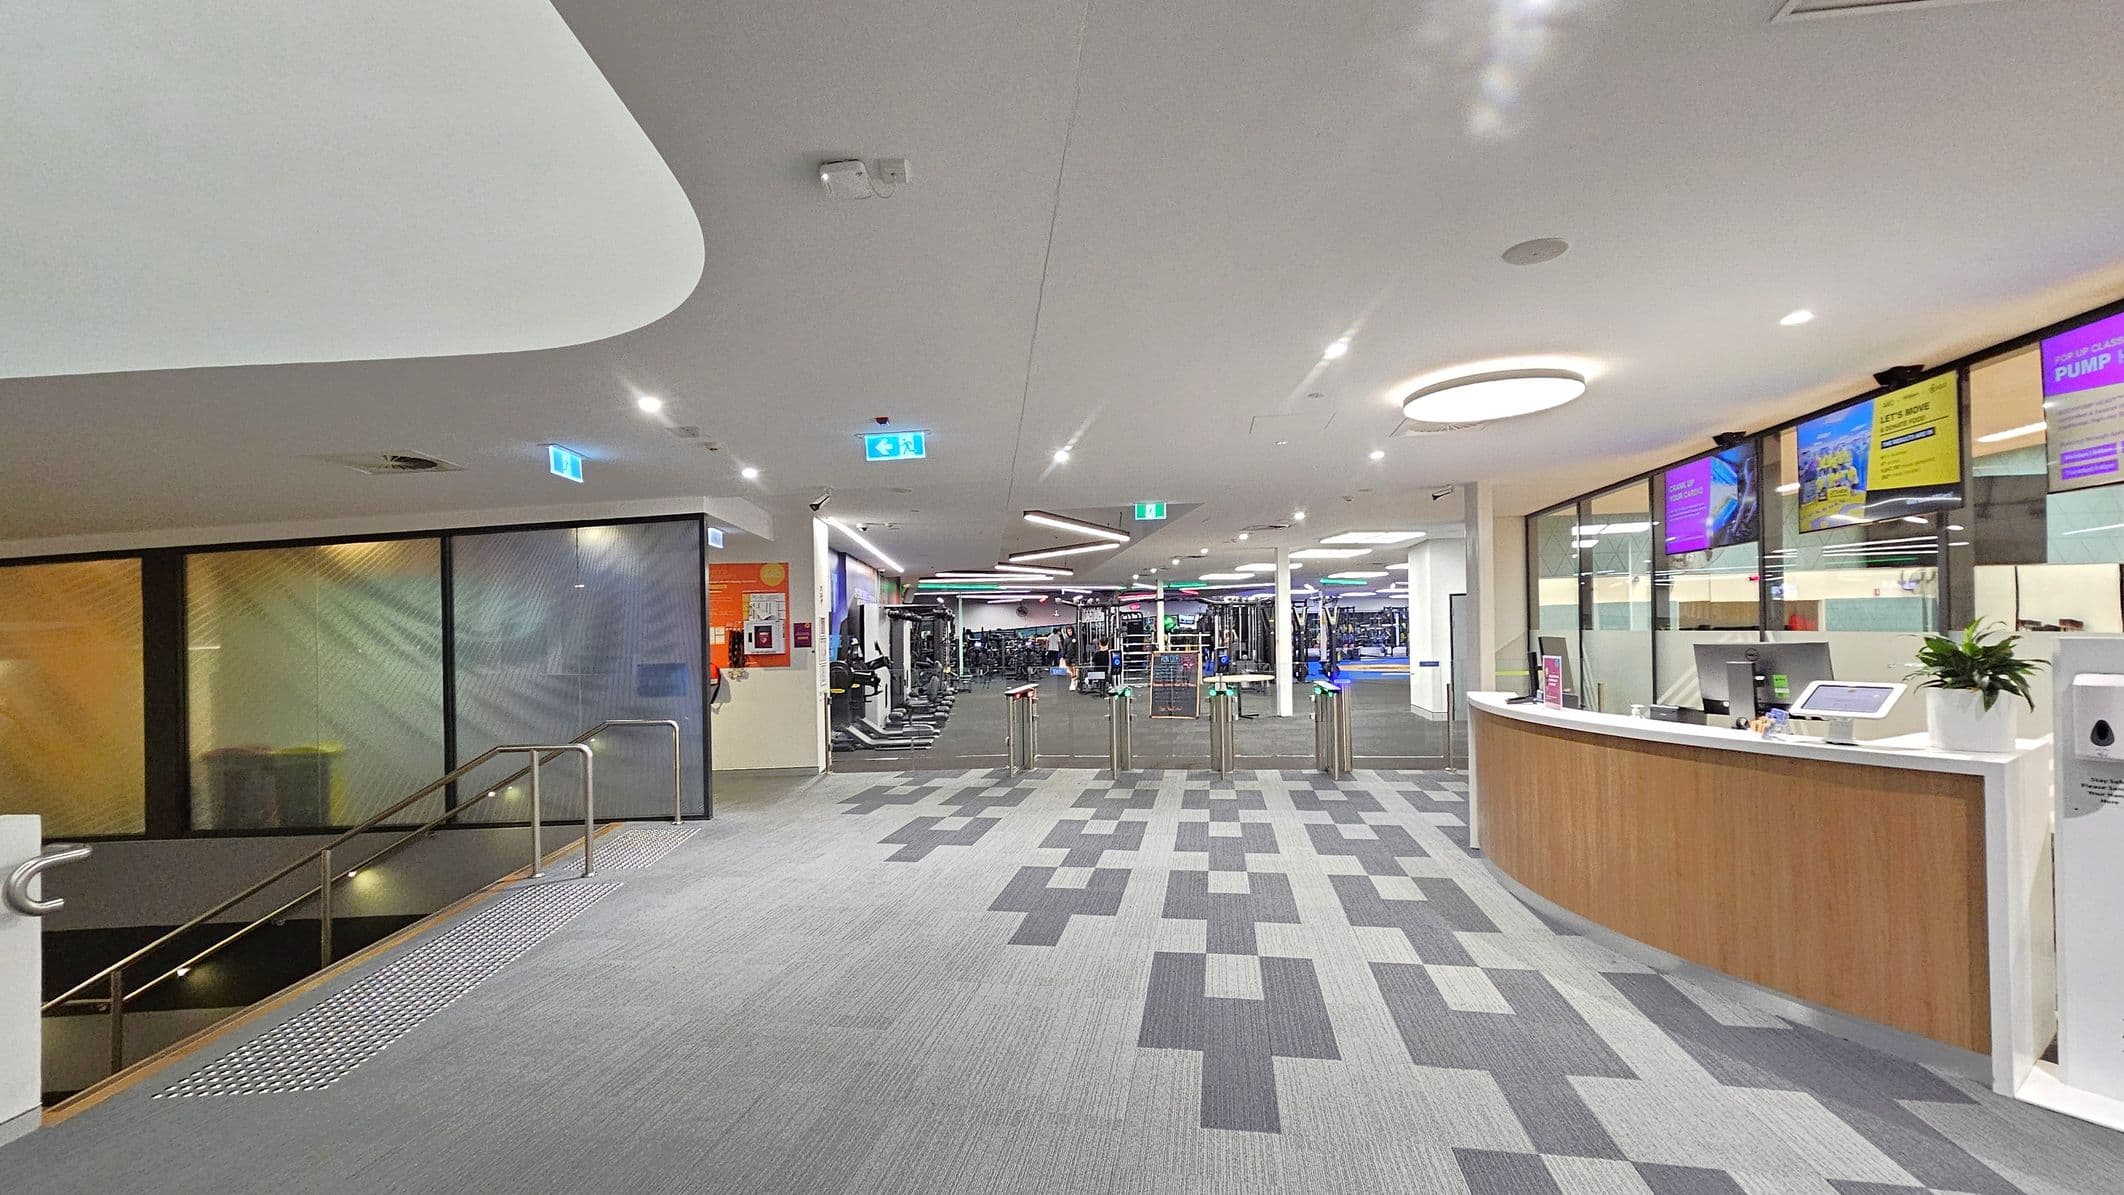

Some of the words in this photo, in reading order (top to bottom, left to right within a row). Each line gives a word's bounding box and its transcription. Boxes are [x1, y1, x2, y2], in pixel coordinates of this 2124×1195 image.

[2076, 347, 2089, 357] UP
[2055, 353, 2112, 382] PUMP
[1880, 410, 1903, 424] LET'S
[1905, 401, 1930, 416] MOVE
[1885, 419, 1907, 432] DONATE
[1670, 481, 1686, 493] CRANK
[1687, 479, 1696, 488] UP
[1670, 492, 1683, 502] YOUR
[1684, 486, 1704, 499] CARDIO
